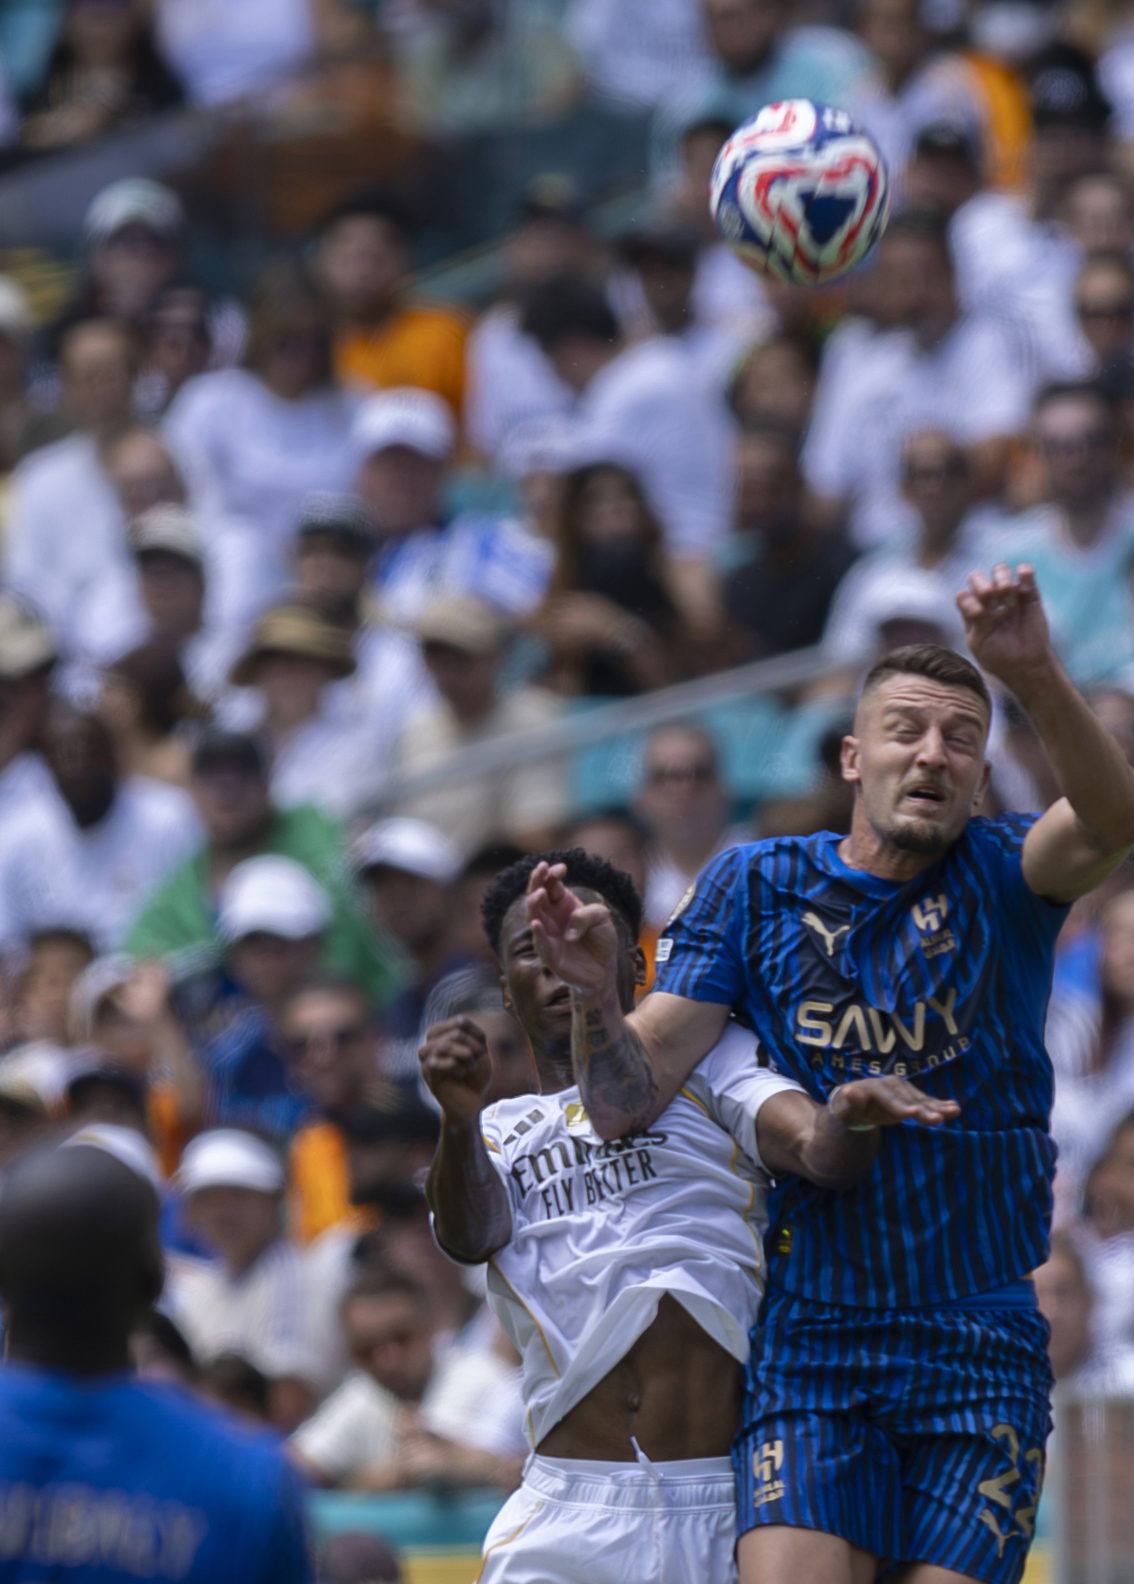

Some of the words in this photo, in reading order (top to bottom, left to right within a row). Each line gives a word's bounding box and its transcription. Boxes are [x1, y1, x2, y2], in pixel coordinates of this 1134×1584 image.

[795, 987, 958, 1053] SAVVY
[811, 1052, 882, 1075] AMES
[541, 1177, 573, 1219] FLY
